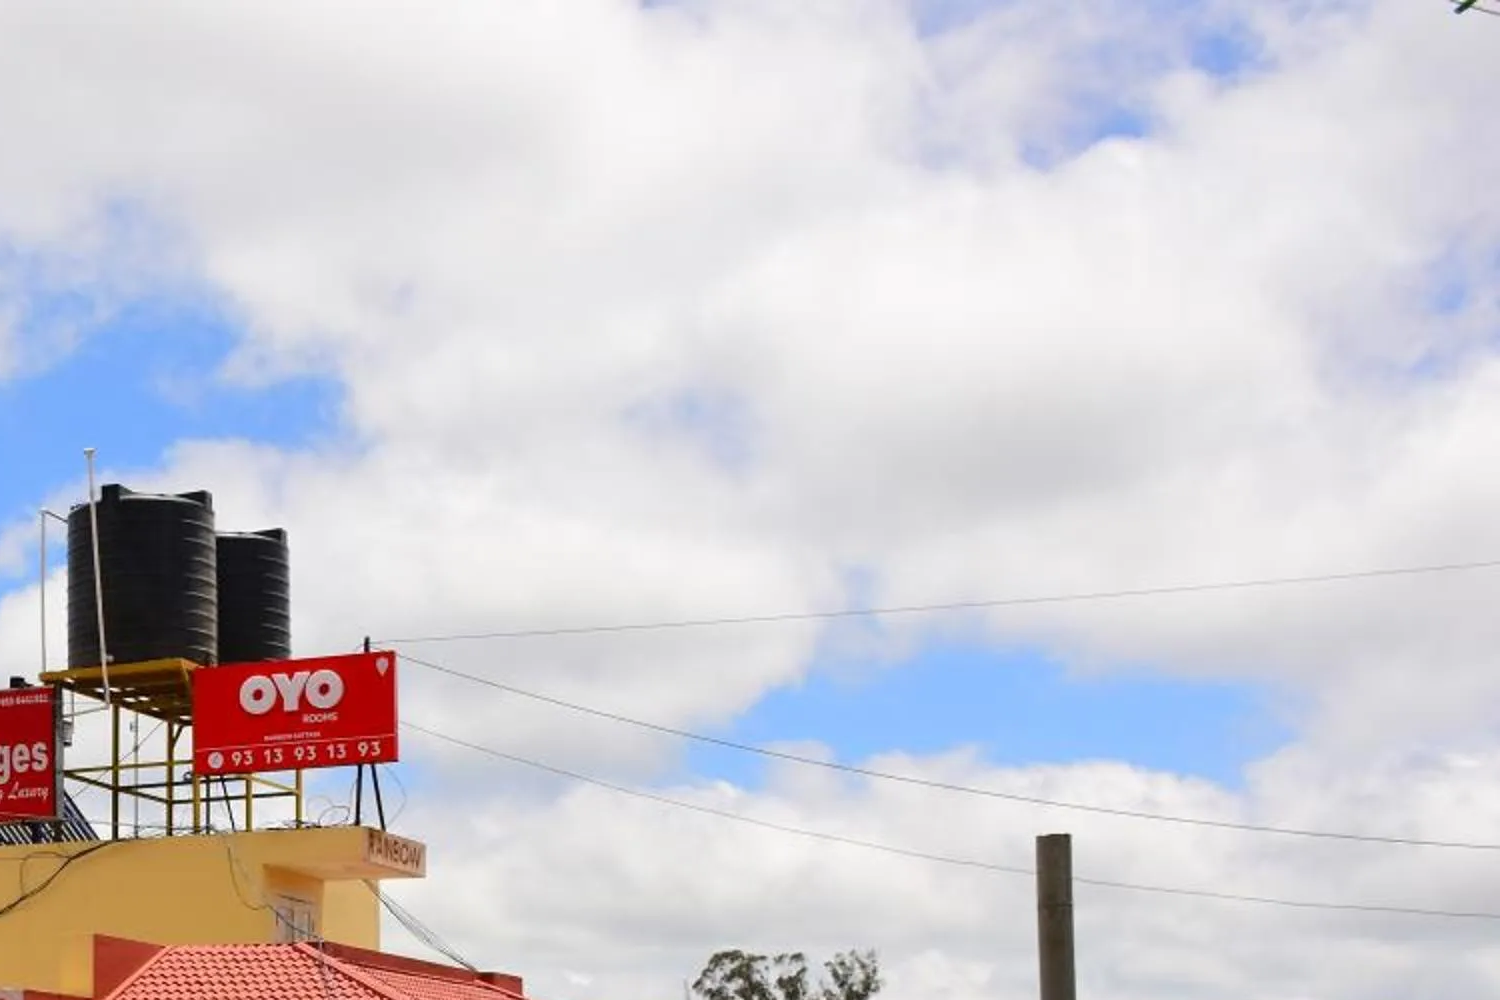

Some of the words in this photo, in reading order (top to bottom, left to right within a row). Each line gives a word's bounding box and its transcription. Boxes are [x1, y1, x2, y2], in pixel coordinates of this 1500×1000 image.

[239, 669, 345, 715] OYO
[302, 712, 339, 723] ROOMS
[231, 750, 253, 767] 93
[264, 747, 284, 765] 13
[294, 745, 317, 761] 93
[326, 743, 347, 759] 13
[357, 740, 381, 757] 93
[8, 781, 49, 803] Luxury
